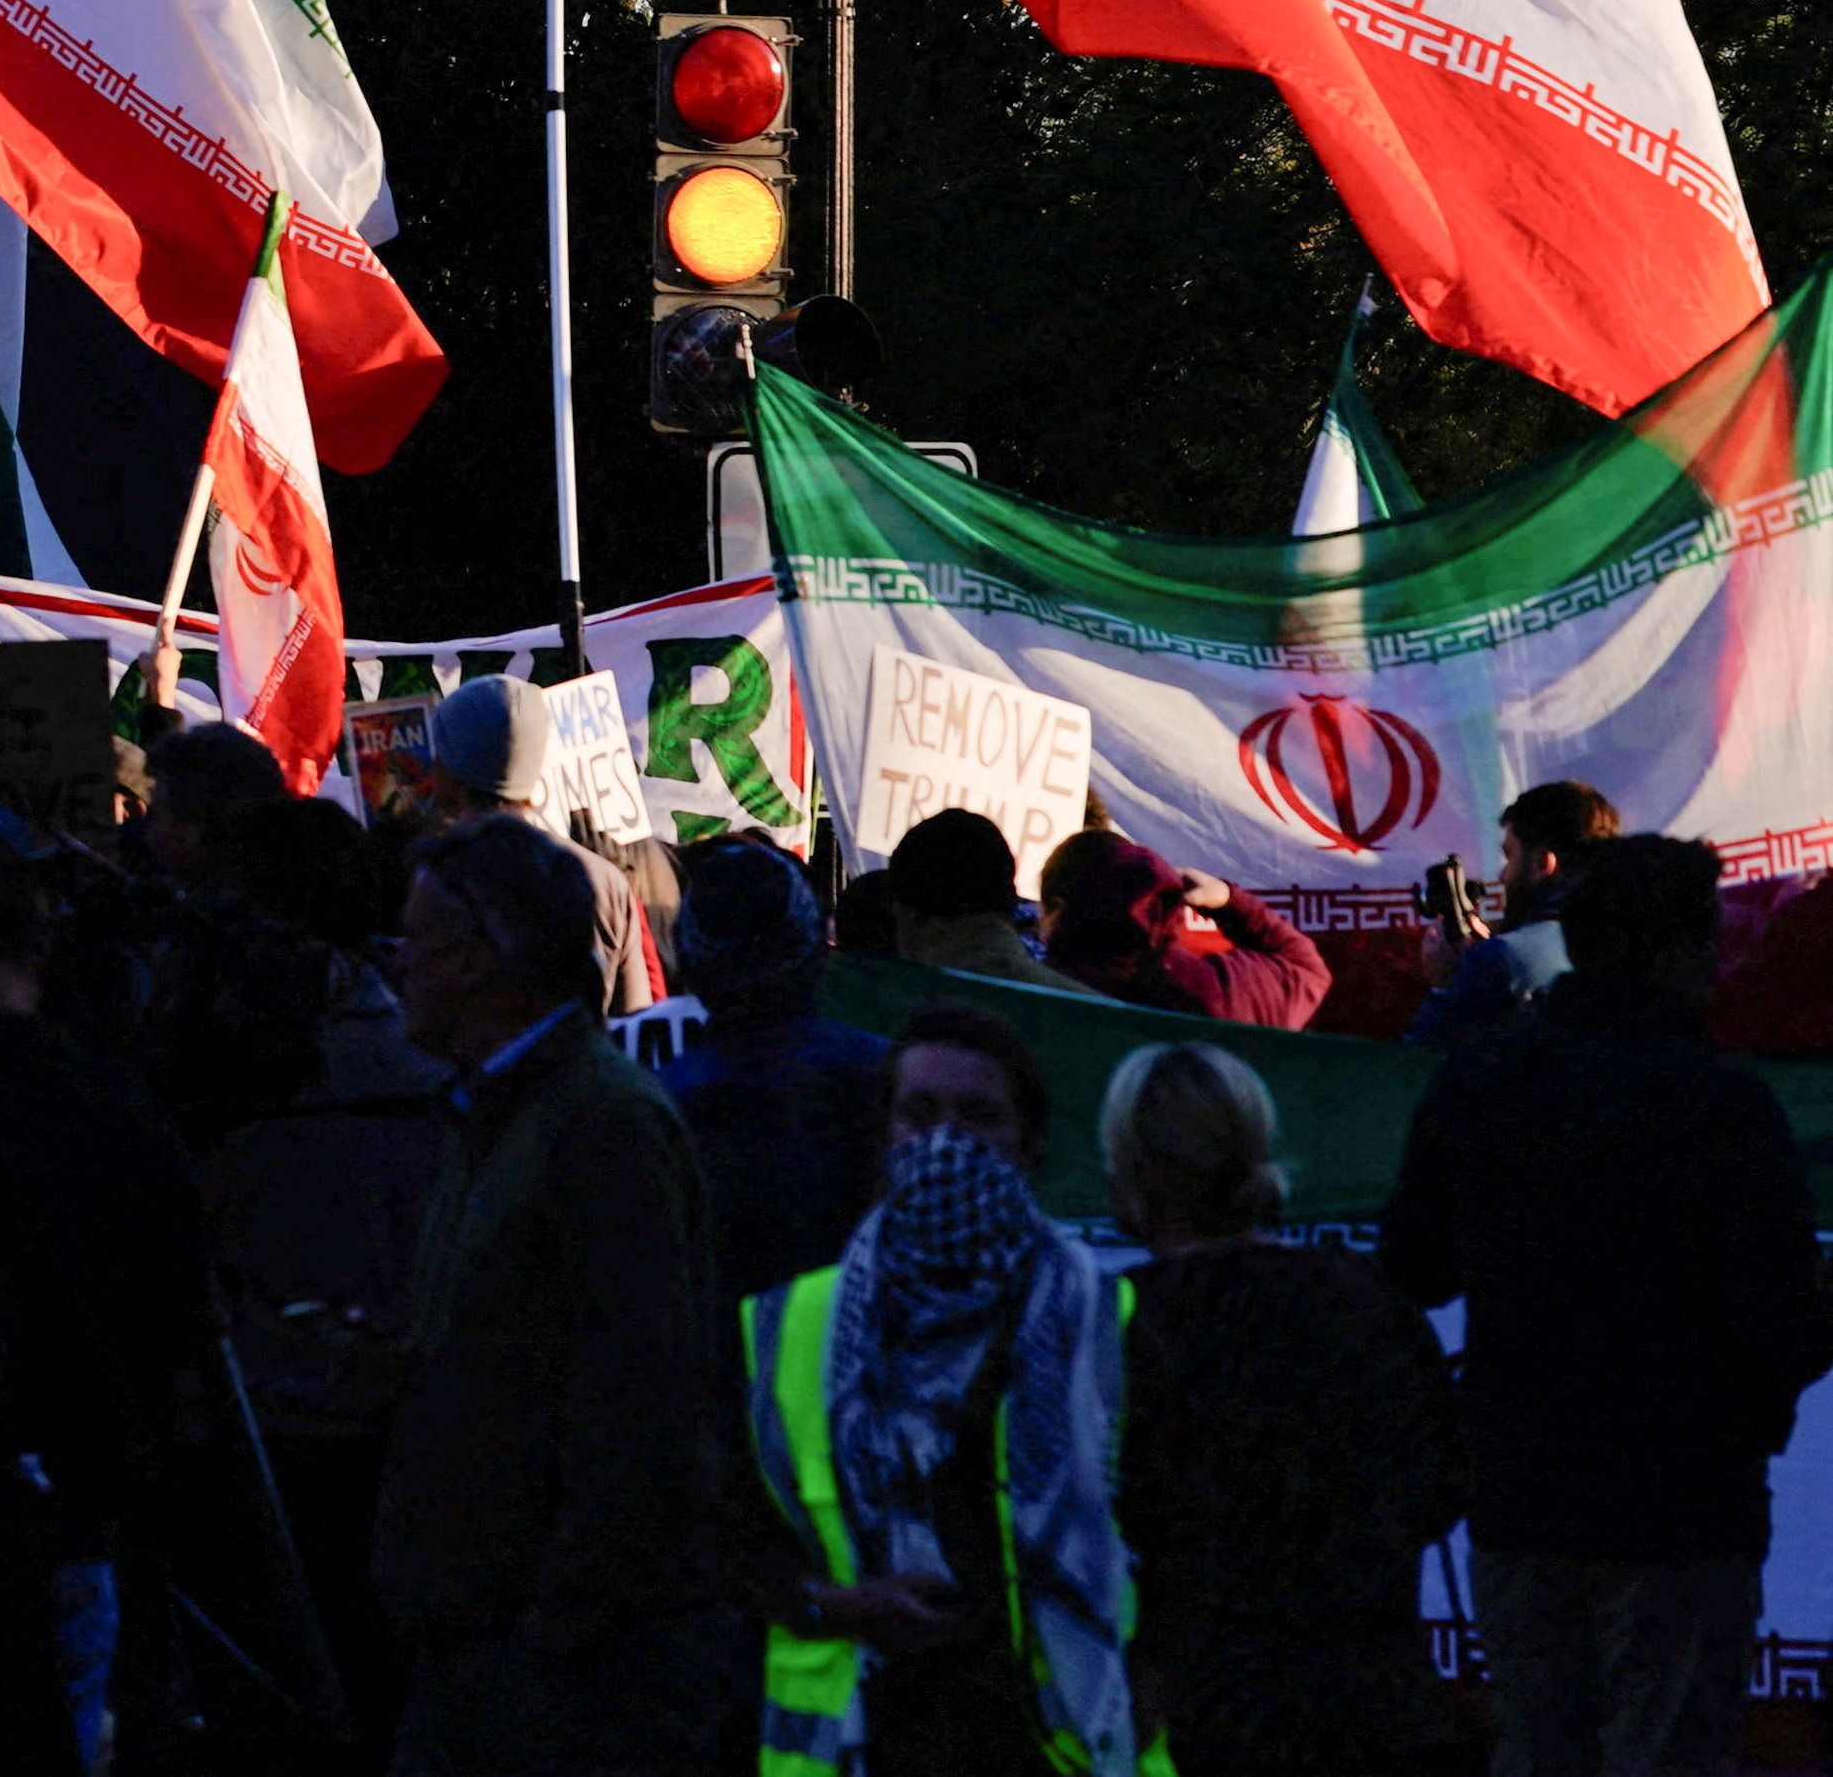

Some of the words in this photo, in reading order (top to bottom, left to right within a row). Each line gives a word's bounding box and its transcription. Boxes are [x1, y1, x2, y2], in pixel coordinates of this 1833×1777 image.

[362, 724, 425, 756] IRAN
[548, 684, 619, 748] WAR
[890, 657, 1081, 797] REMOVE
[535, 746, 639, 833] RIMES
